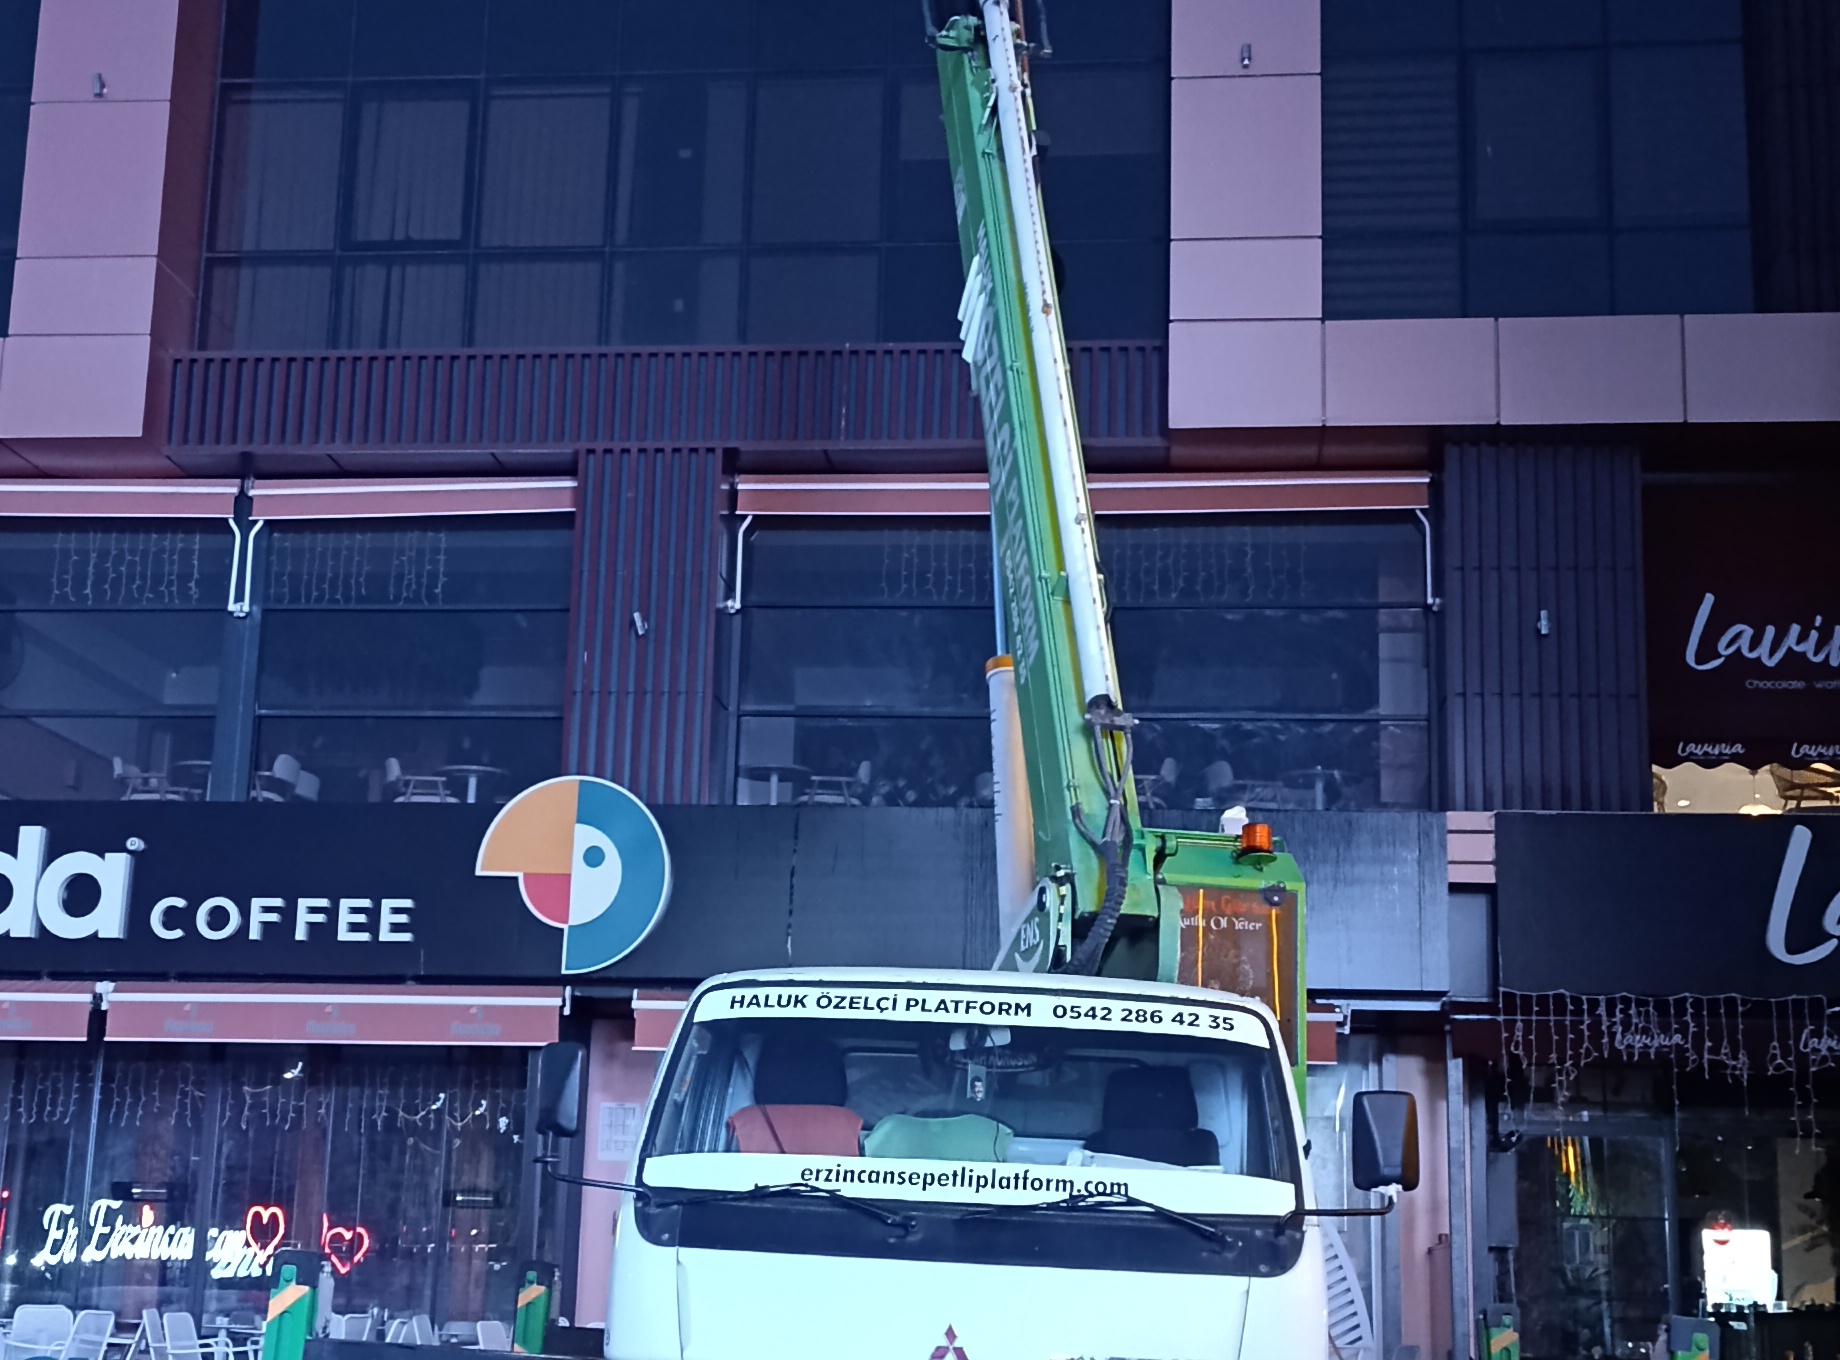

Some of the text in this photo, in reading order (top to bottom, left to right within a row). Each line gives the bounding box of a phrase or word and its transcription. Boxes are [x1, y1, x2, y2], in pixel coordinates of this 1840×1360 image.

[1677, 740, 1746, 756] Lavinia
[150, 896, 415, 942] COFFEE
[729, 991, 1236, 1032] HALUK ÖZELÇİ PLATFORM 0542 286 42 35
[800, 1163, 1129, 1196] erzincansepetliplatform.com
